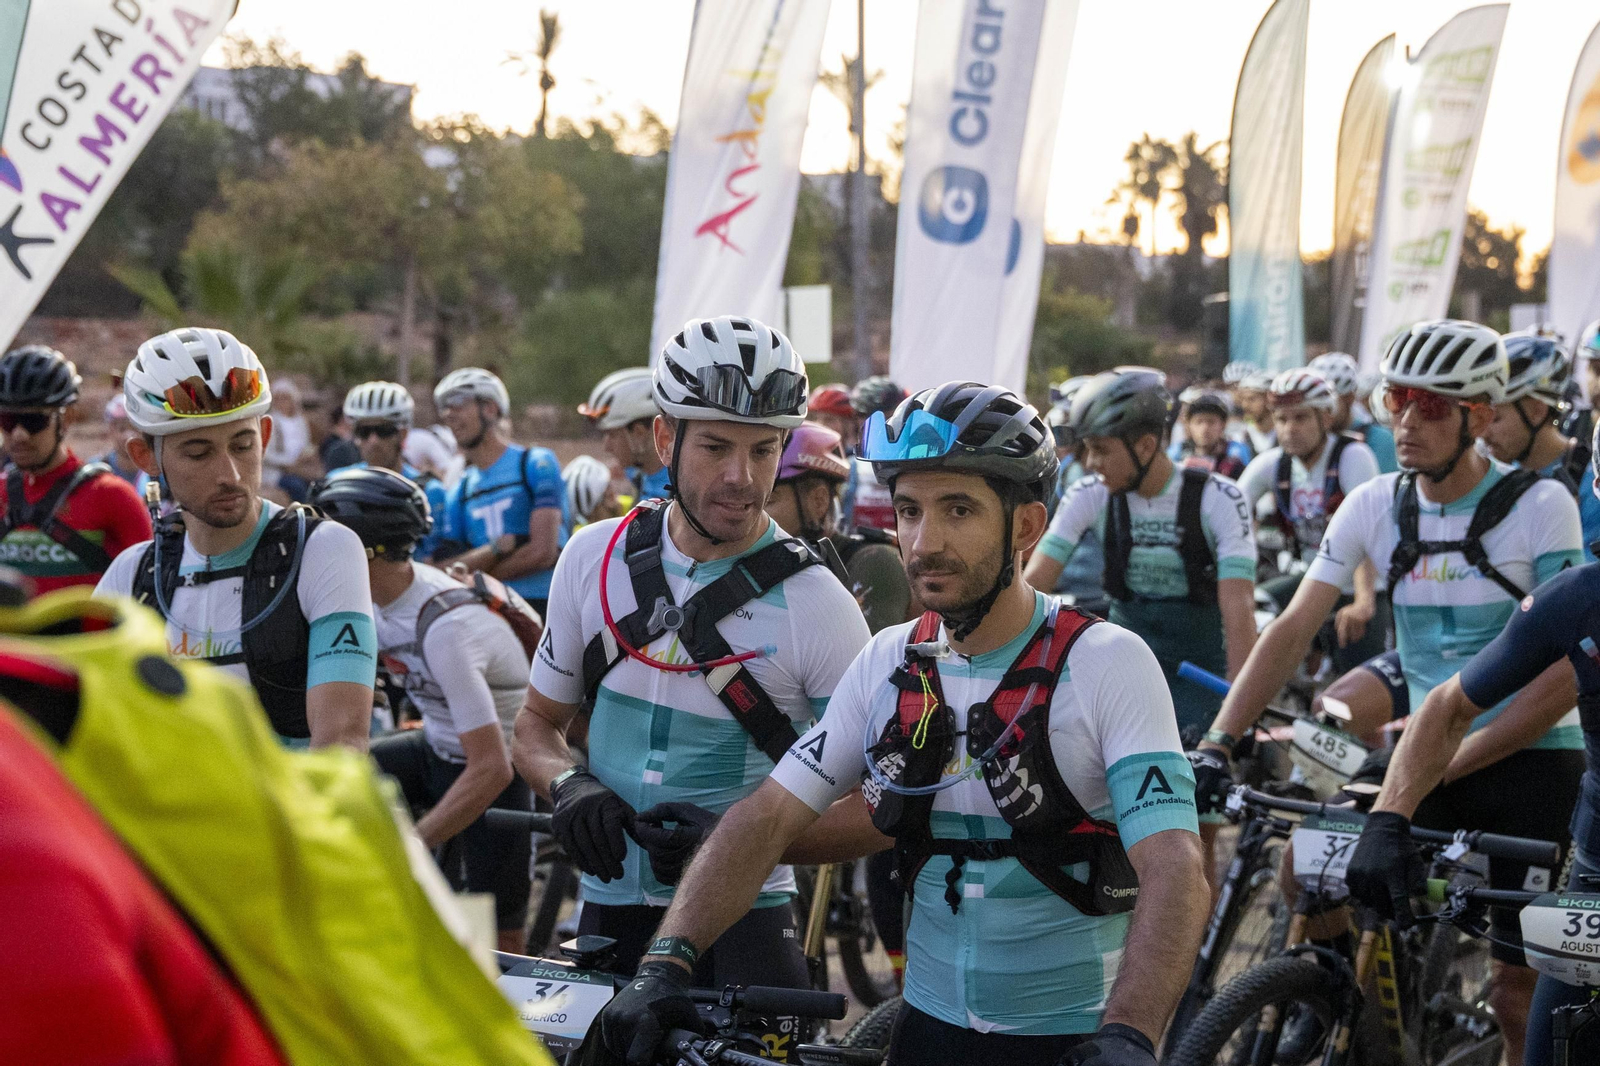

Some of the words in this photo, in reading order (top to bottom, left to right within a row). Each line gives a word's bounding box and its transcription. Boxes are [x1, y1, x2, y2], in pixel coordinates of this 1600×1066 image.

[950, 0, 1005, 147] Clear
[21, 27, 123, 150] COSTA
[39, 8, 210, 232] ALMERÍA
[1311, 731, 1347, 759] 485
[800, 757, 836, 787] Andalucía
[1119, 805, 1140, 822] Junta
[1142, 800, 1155, 809] de
[1156, 796, 1195, 808] Andalucía
[1562, 911, 1600, 940] 39
[1560, 940, 1600, 954] AGUST
